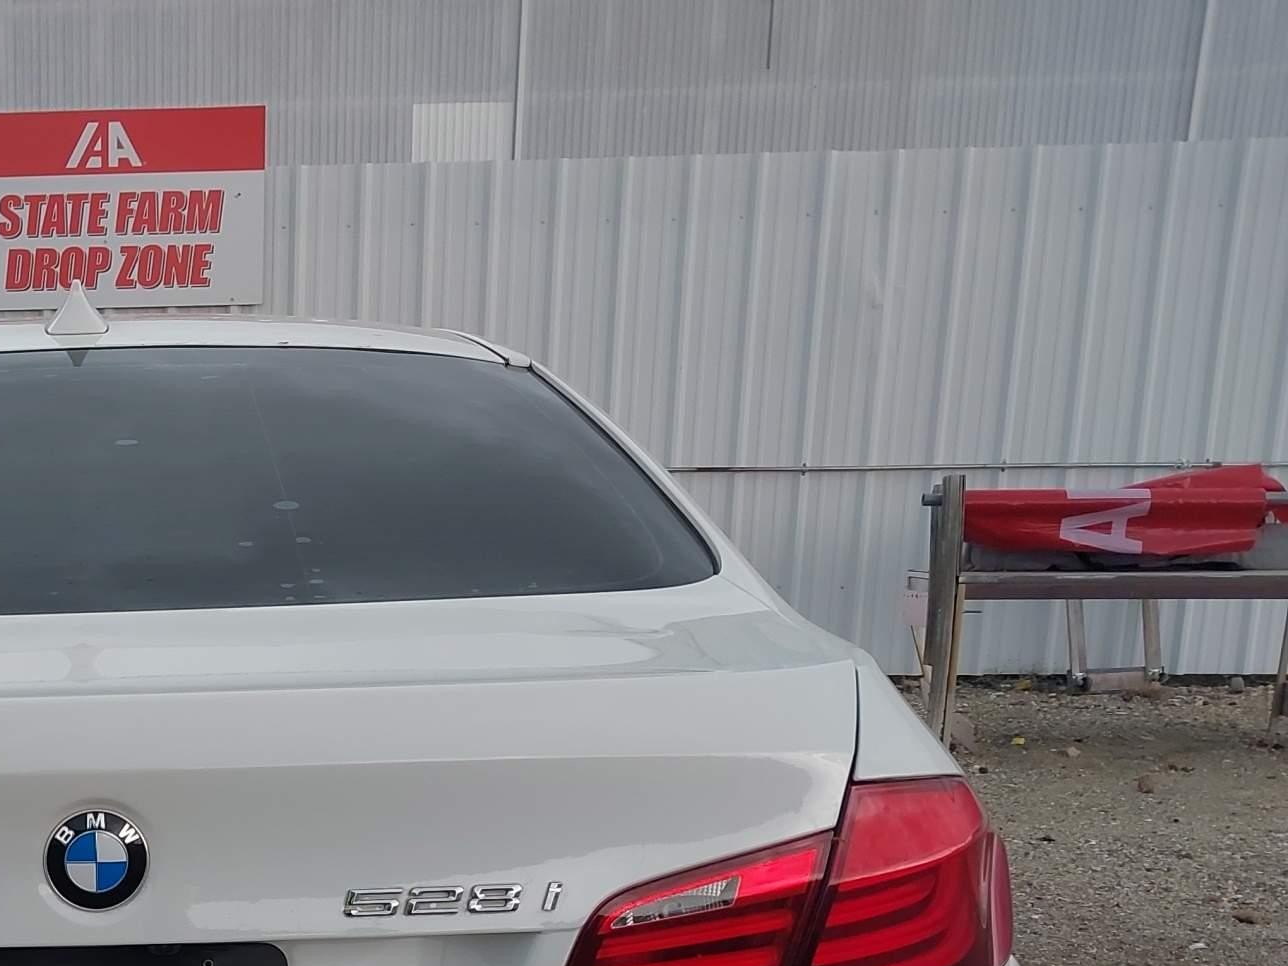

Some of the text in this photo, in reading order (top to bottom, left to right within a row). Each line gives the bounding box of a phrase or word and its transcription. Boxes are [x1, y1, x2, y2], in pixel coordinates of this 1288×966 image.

[114, 189, 224, 235] FARM
[4, 244, 214, 292] DROP ZONE
[54, 812, 140, 845] BMW
